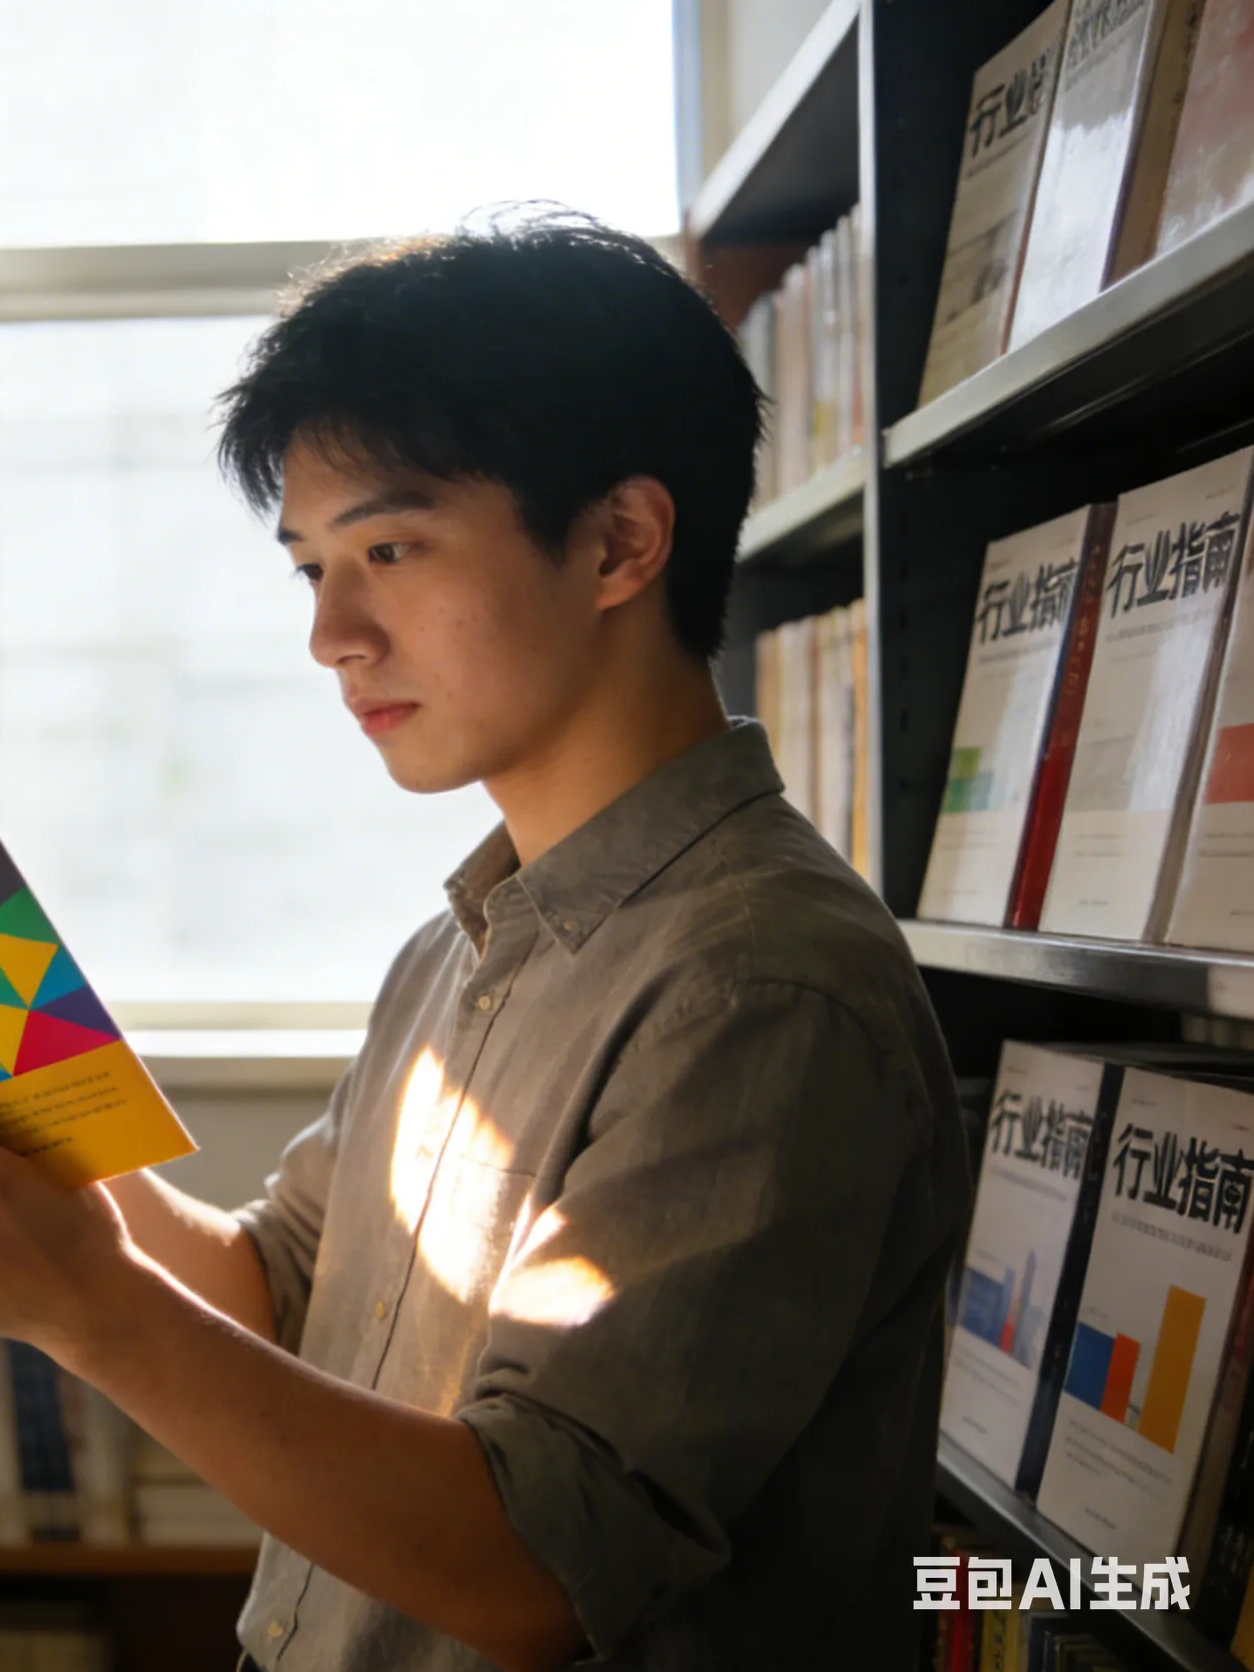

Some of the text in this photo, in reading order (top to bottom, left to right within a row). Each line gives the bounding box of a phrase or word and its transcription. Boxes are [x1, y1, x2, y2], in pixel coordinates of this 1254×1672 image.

[1106, 509, 1242, 619] 行业指南
[1112, 1121, 1254, 1235] 行业指南
